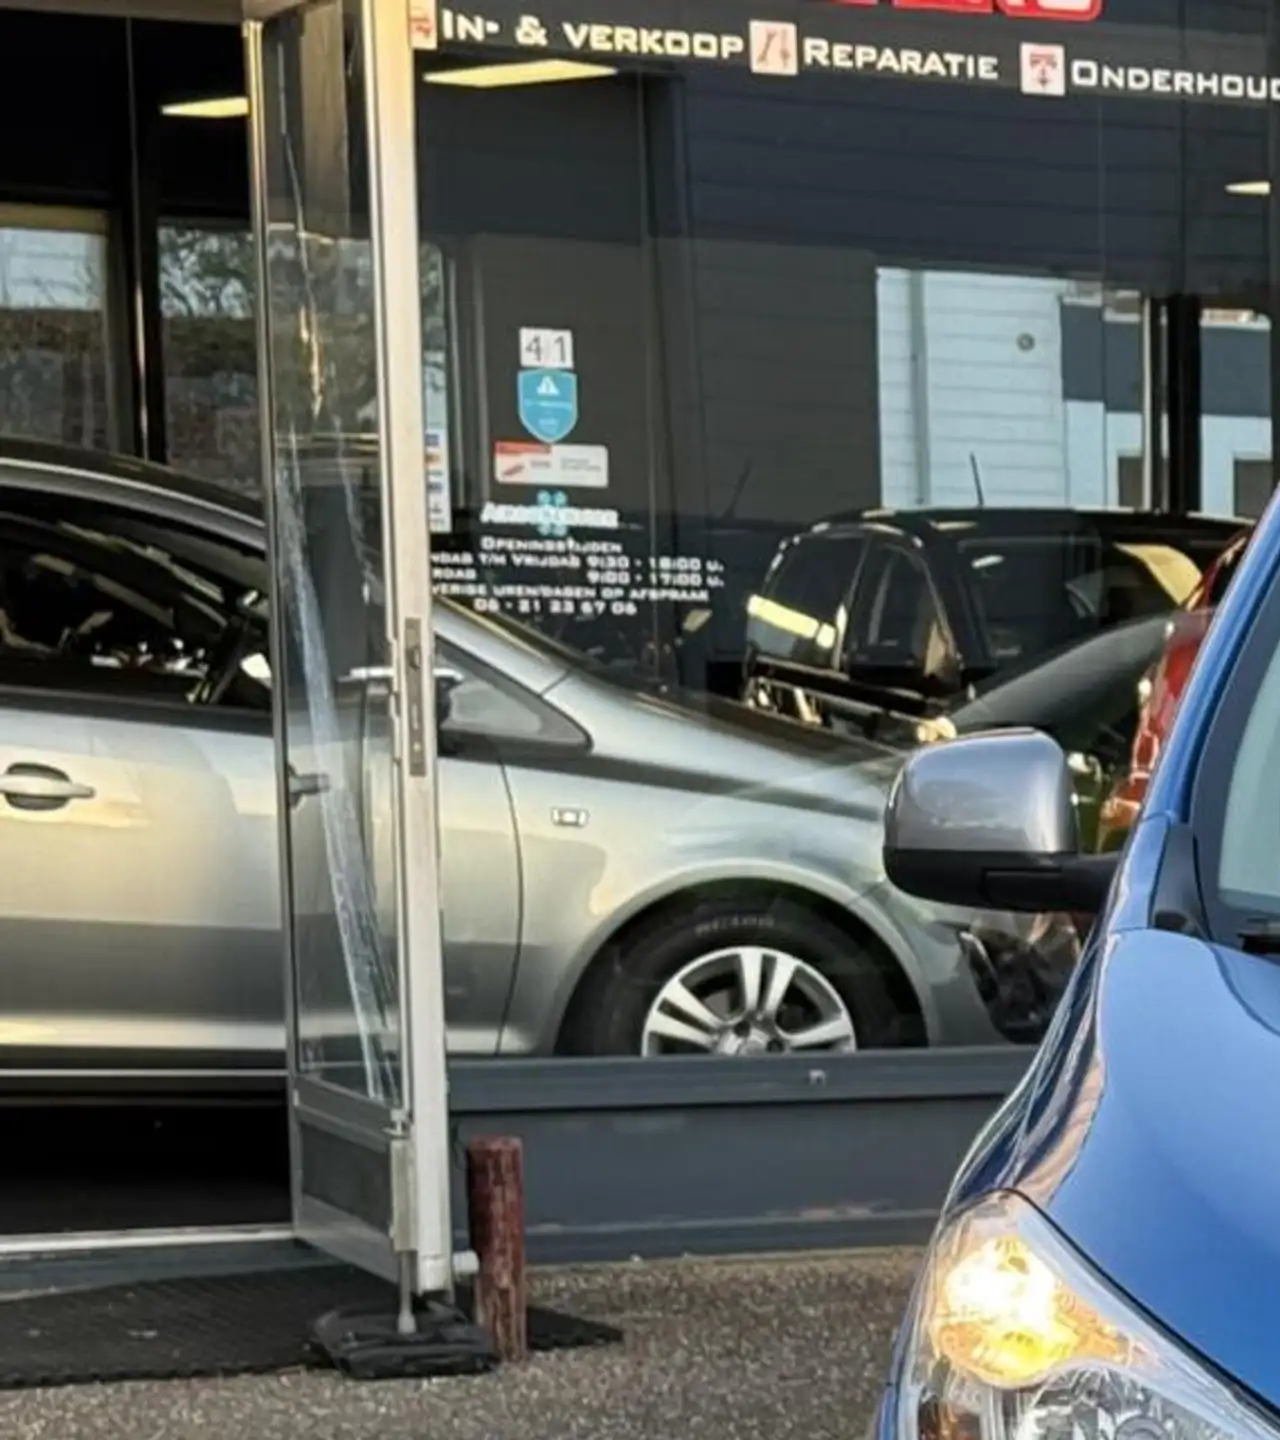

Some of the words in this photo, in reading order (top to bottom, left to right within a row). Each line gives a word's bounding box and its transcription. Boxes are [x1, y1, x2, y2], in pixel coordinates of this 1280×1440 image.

[442, 8, 499, 42] IN-
[515, 15, 548, 46] &
[562, 22, 745, 60] VERKOOP
[804, 36, 999, 80] REPARATIE
[525, 335, 566, 364] 41
[511, 553, 580, 568] VRIJDAG
[601, 586, 624, 600] OP
